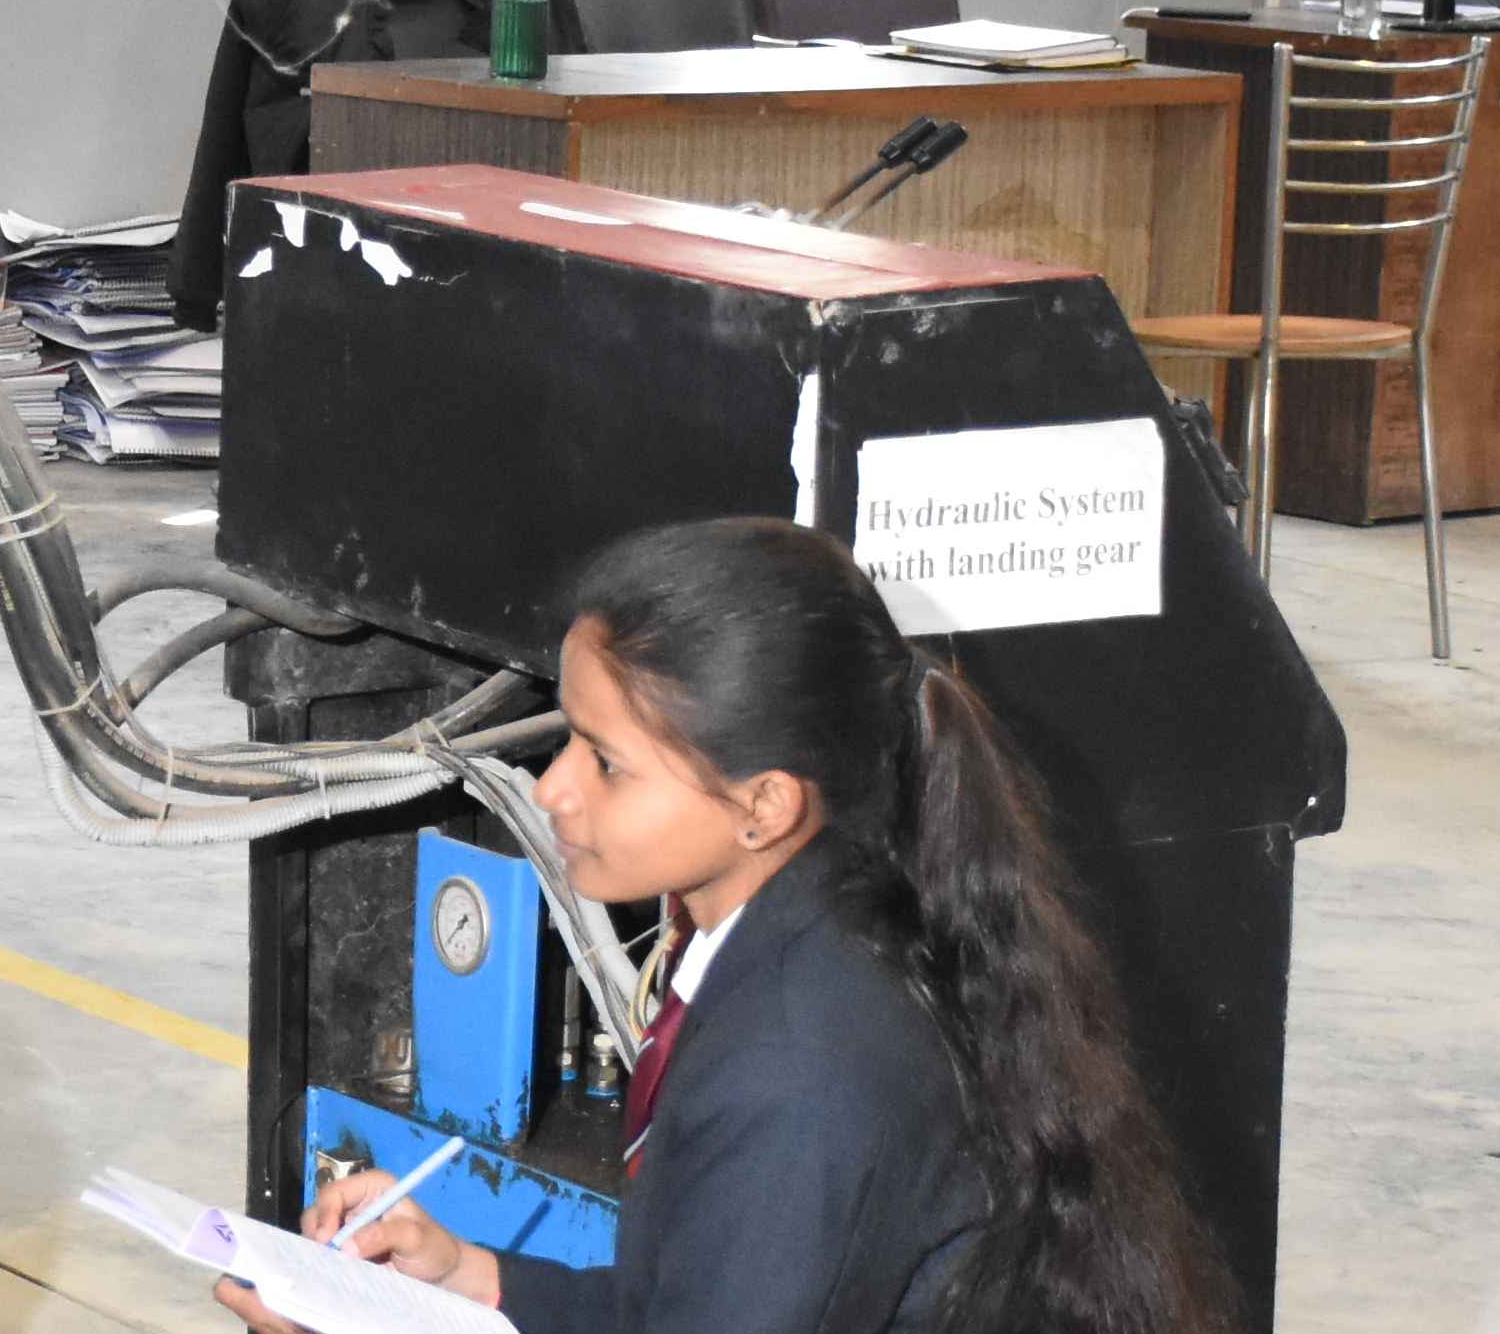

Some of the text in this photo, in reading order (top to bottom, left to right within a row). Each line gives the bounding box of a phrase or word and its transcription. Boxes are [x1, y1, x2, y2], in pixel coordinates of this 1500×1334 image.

[868, 485, 1145, 539] Hydraulic System
[866, 539, 1142, 583] with landing gear
